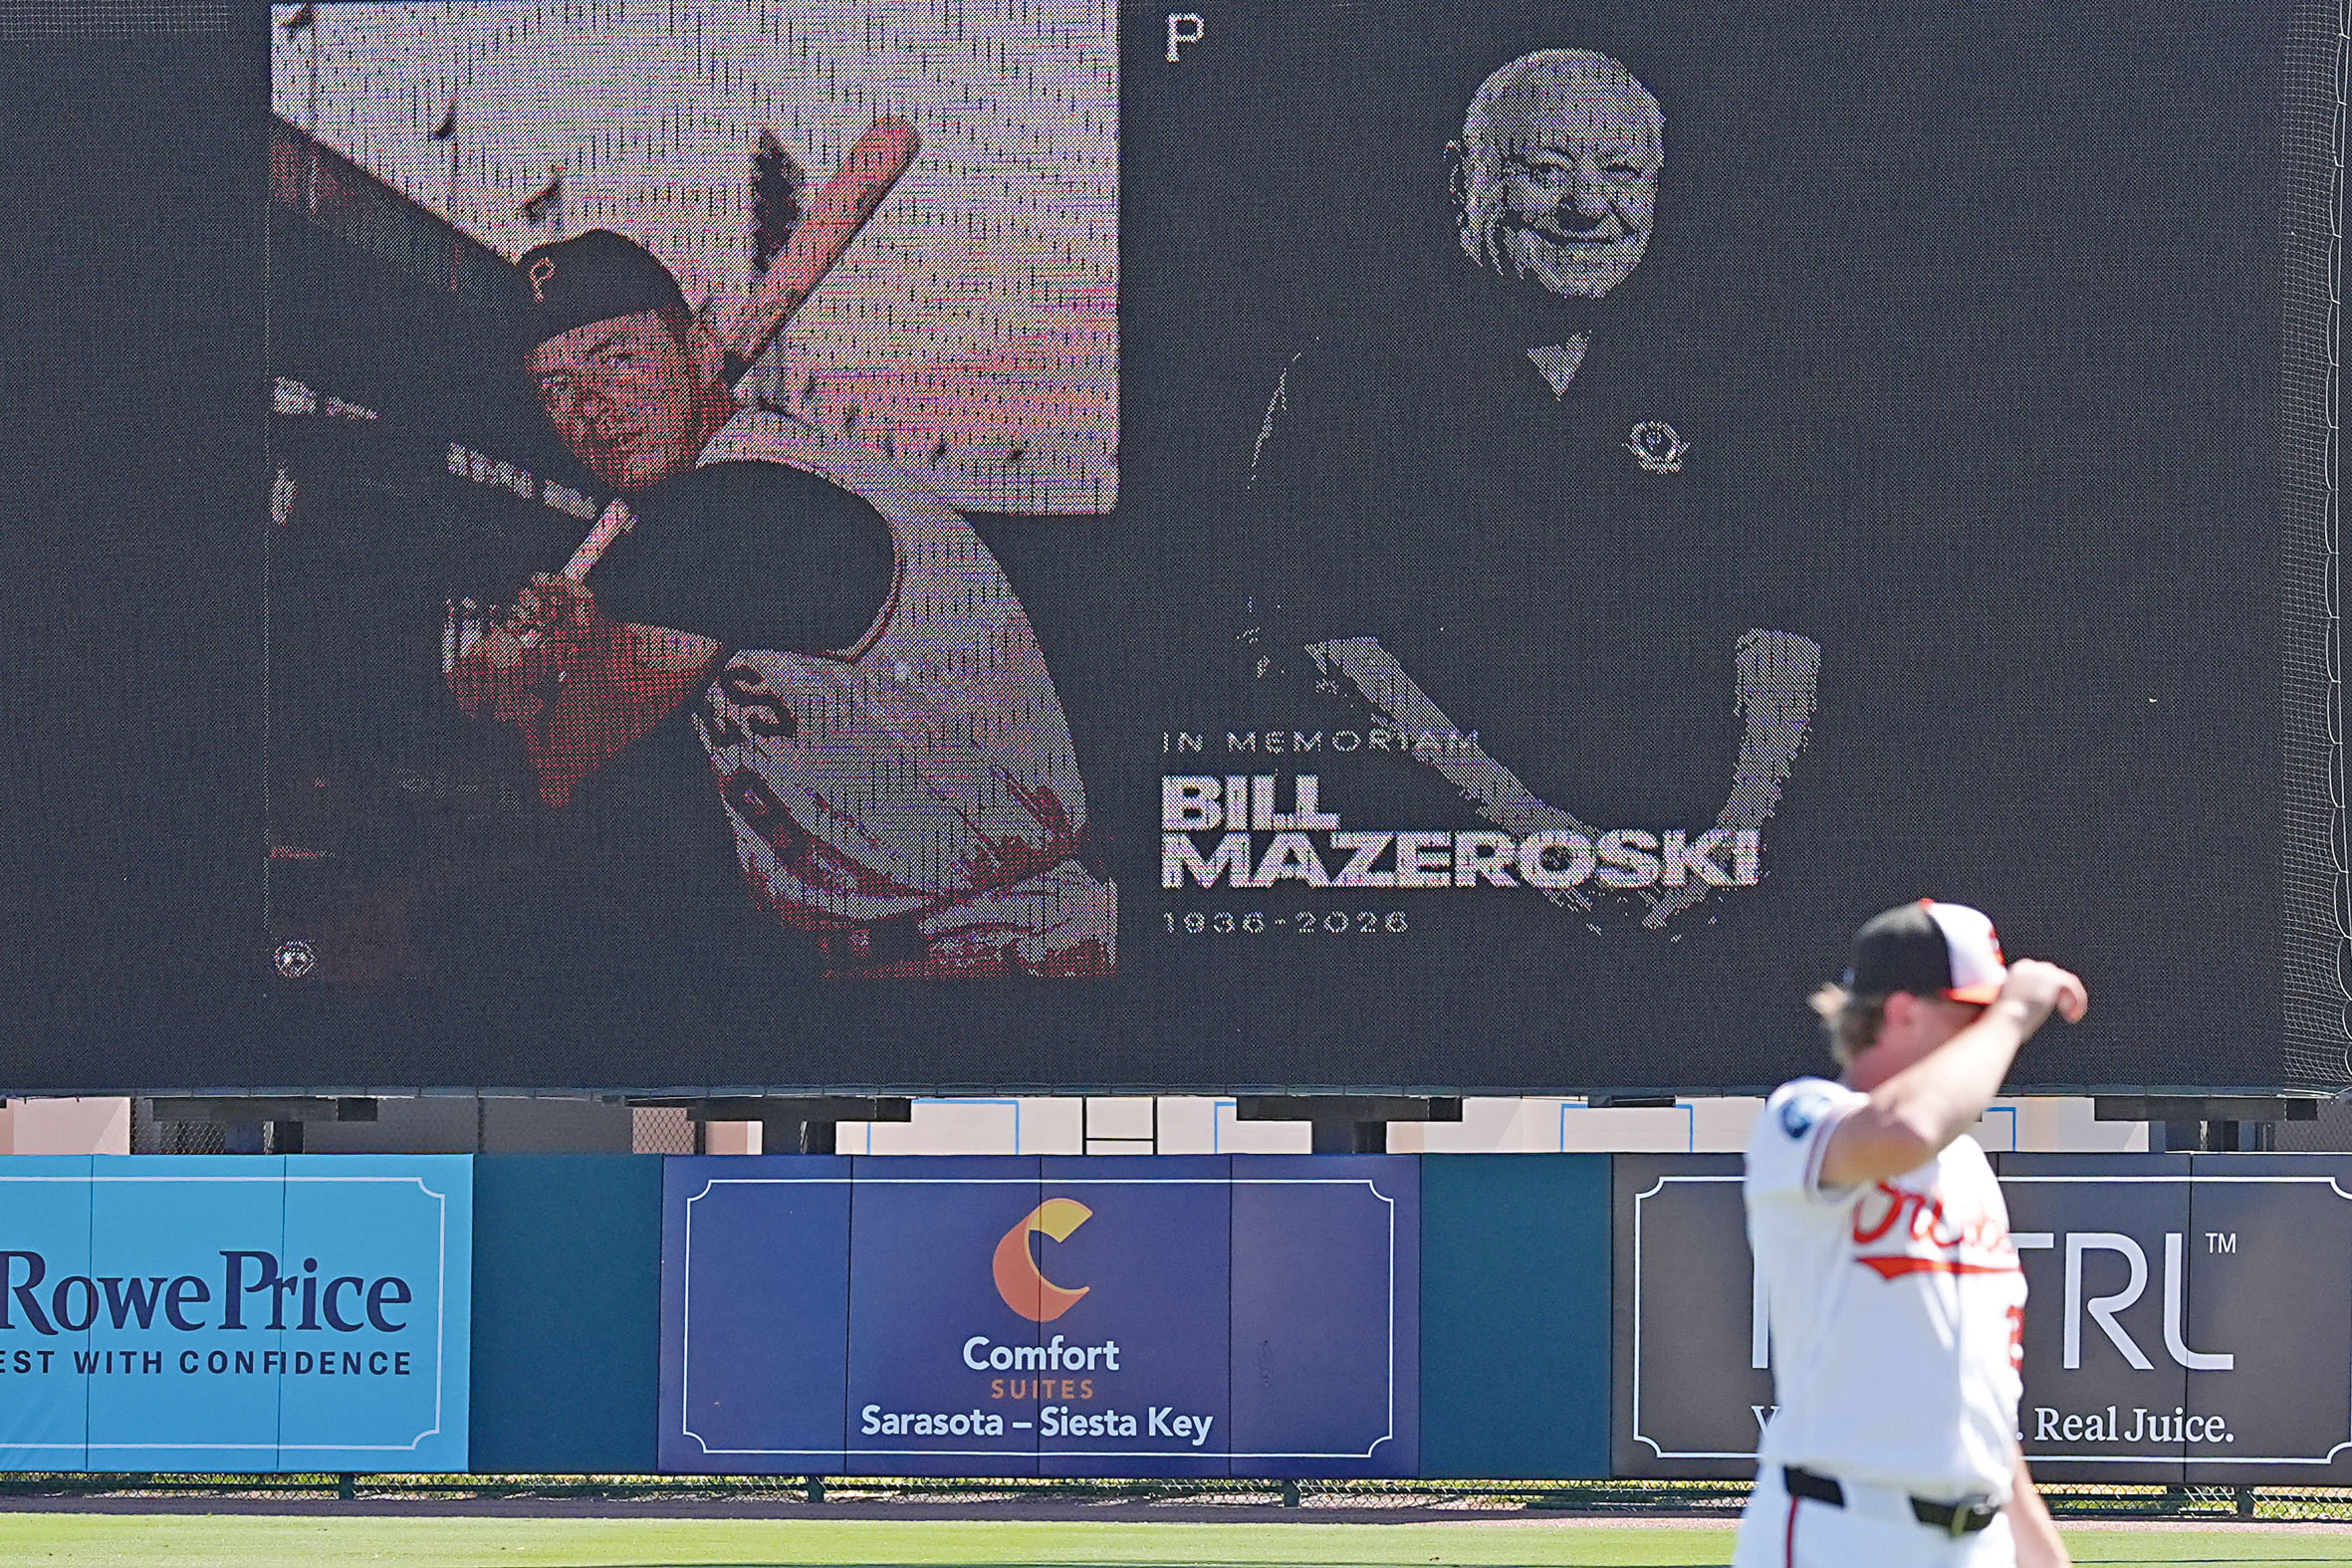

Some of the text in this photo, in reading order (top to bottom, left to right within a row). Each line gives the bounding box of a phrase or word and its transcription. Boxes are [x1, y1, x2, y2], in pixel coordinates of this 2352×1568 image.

[1165, 12, 1205, 63] P
[1162, 729, 1480, 754] IN MEMORIAM
[1161, 774, 1341, 831] BILL
[1161, 829, 1761, 889] MAZEROSKI
[1163, 910, 1410, 934] 1936-2026
[0, 1250, 412, 1336] Rowe Price
[73, 1350, 163, 1375] WITH
[178, 1350, 412, 1376] CONFIDENCE
[962, 1334, 1120, 1371] Comfort
[991, 1378, 1094, 1401] SUITES
[860, 1404, 1004, 1437] Sarasota
[1040, 1406, 1138, 1438] Siesta
[1148, 1406, 1214, 1447] Key
[2033, 1405, 2120, 1443] Real
[2123, 1406, 2235, 1443] Juice.
